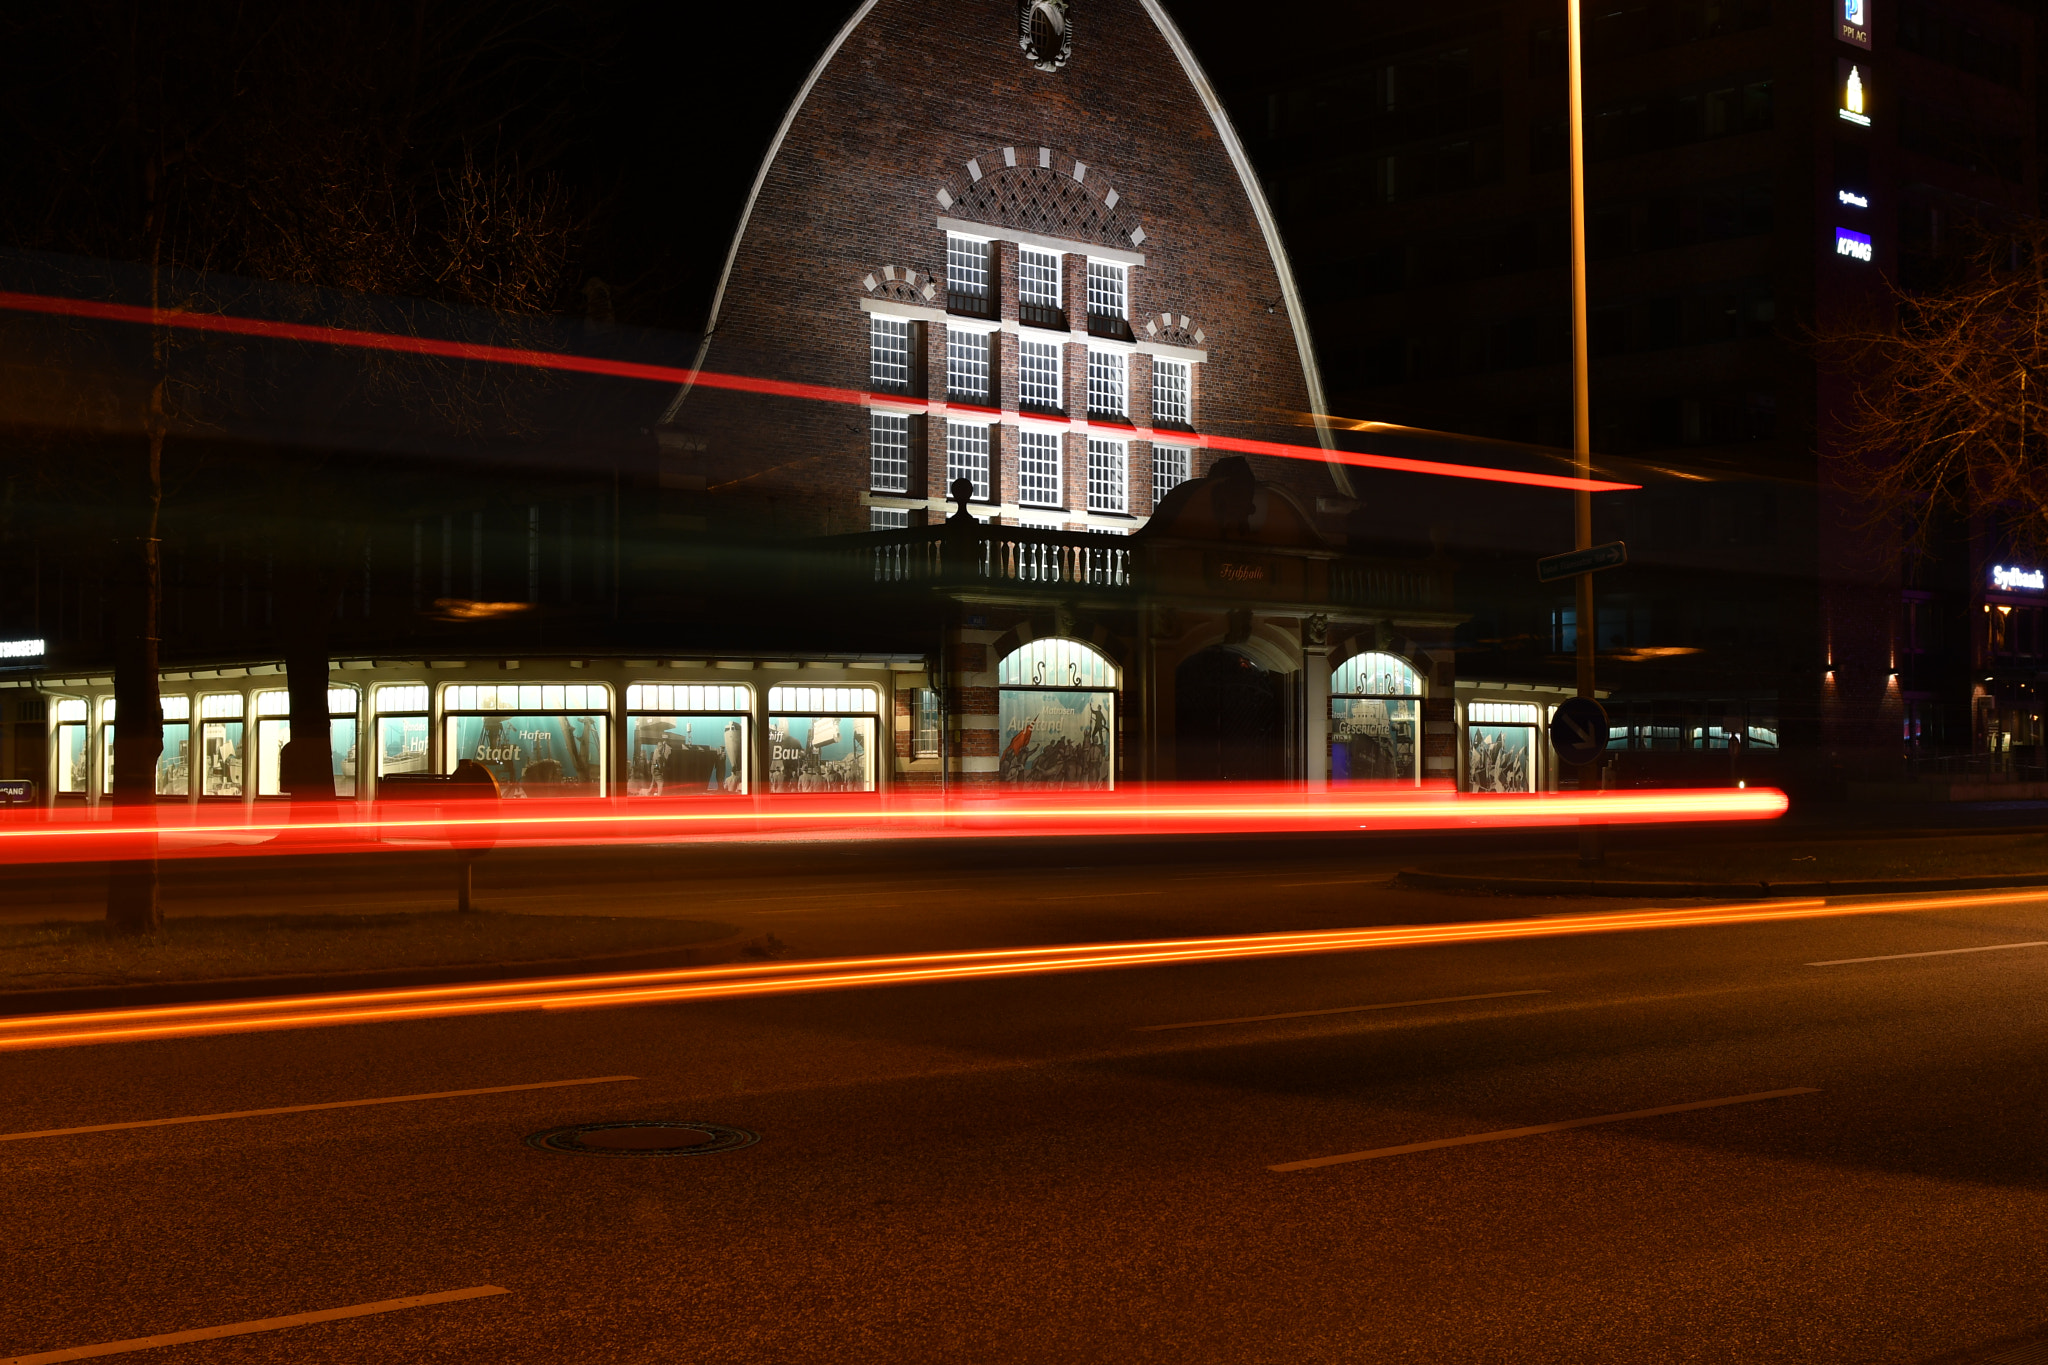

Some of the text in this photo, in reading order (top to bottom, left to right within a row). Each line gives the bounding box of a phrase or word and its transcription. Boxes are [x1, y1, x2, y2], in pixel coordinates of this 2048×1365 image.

[1843, 25, 1867, 42] PPI AG
[1837, 237, 1872, 262] KPMG
[1994, 565, 2044, 589] Sydbank
[1042, 706, 1075, 716] Matrosen
[1007, 717, 1064, 735] Aufstand
[1340, 721, 1390, 735] Geschichte
[519, 730, 552, 742] Hafen
[476, 744, 522, 761] Stadt
